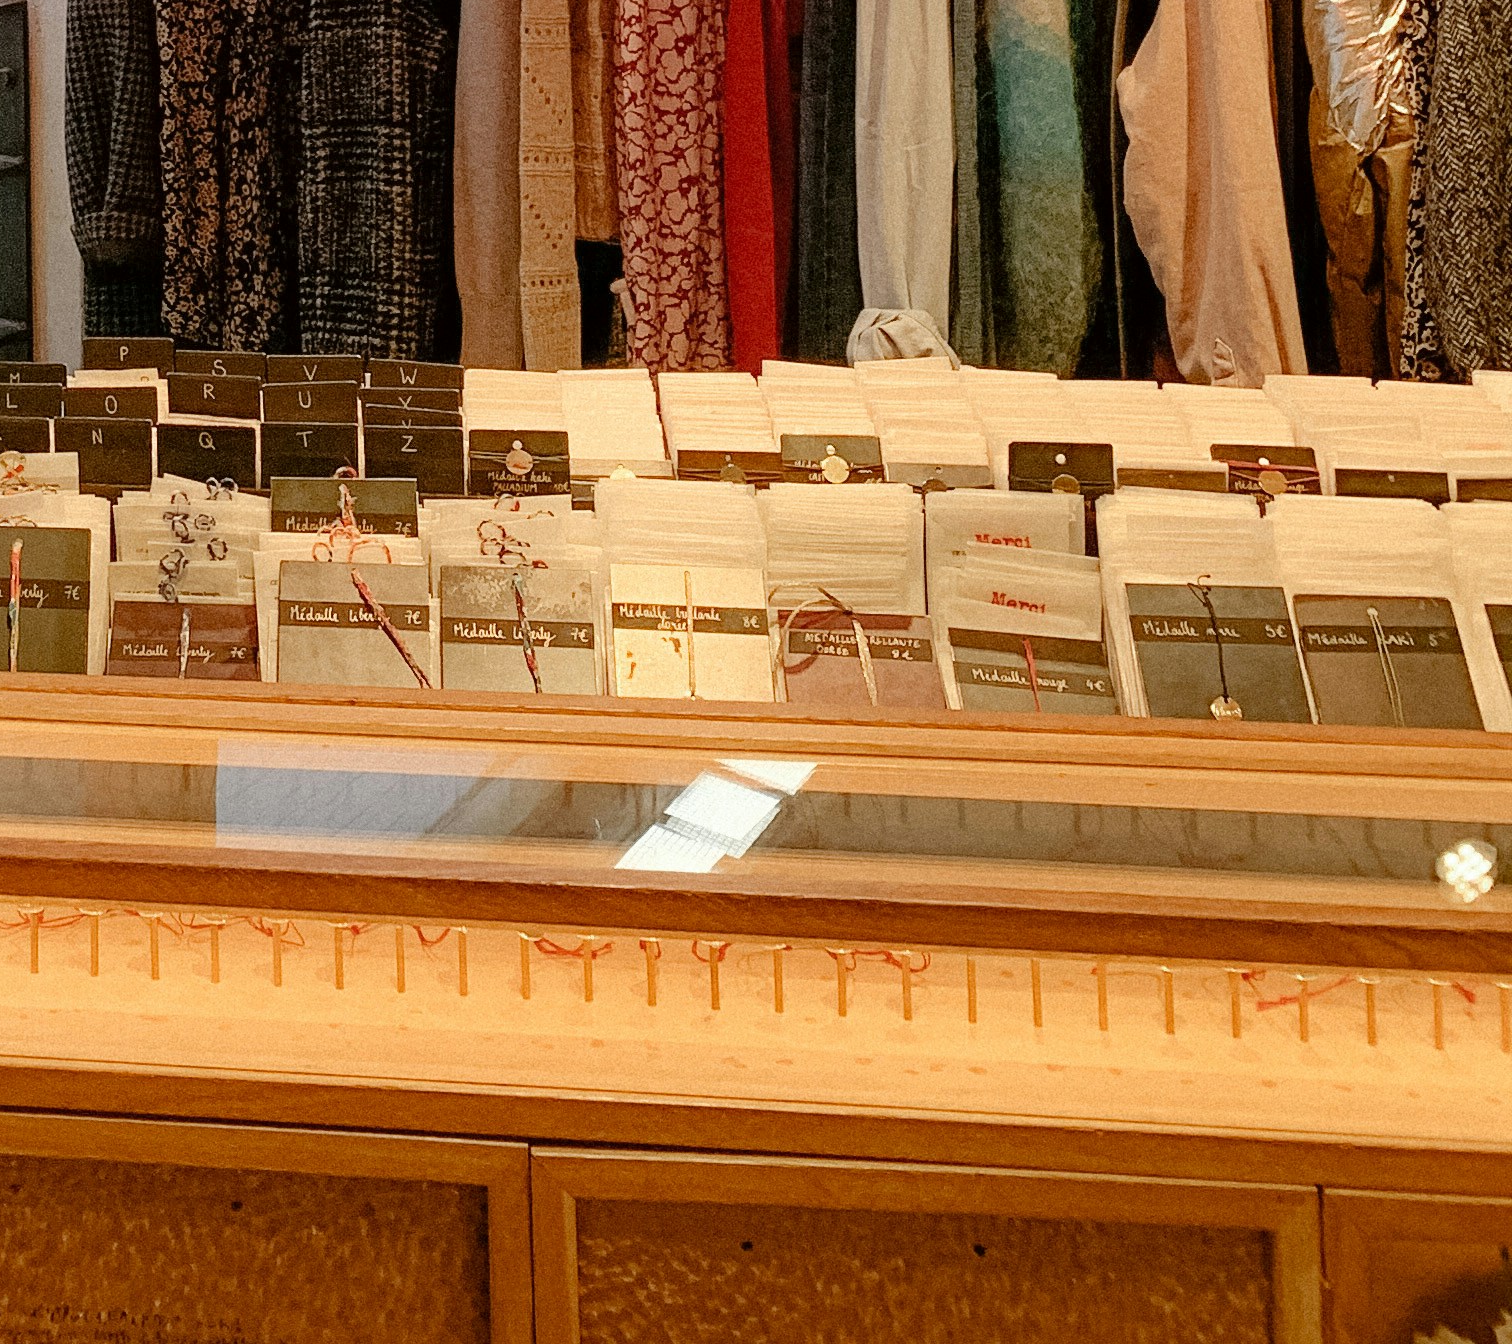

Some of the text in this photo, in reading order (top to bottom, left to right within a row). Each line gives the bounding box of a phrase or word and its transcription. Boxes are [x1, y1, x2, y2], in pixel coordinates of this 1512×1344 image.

[119, 345, 129, 362] P
[211, 359, 227, 377] S
[302, 364, 318, 381] V
[399, 366, 418, 385] W
[203, 383, 216, 400] R
[298, 390, 312, 409] U
[6, 393, 18, 409] L
[91, 427, 103, 445] N
[198, 431, 216, 451] Q
[295, 430, 314, 448] T
[400, 435, 418, 453] Z
[64, 584, 81, 601] 7€
[289, 605, 339, 623] Médaille
[405, 610, 422, 625] 7€
[452, 621, 507, 639] Médaille
[571, 627, 589, 643] 7€
[121, 643, 168, 657] Médaille
[230, 646, 247, 659] 7€
[971, 668, 1030, 686] Médaille
